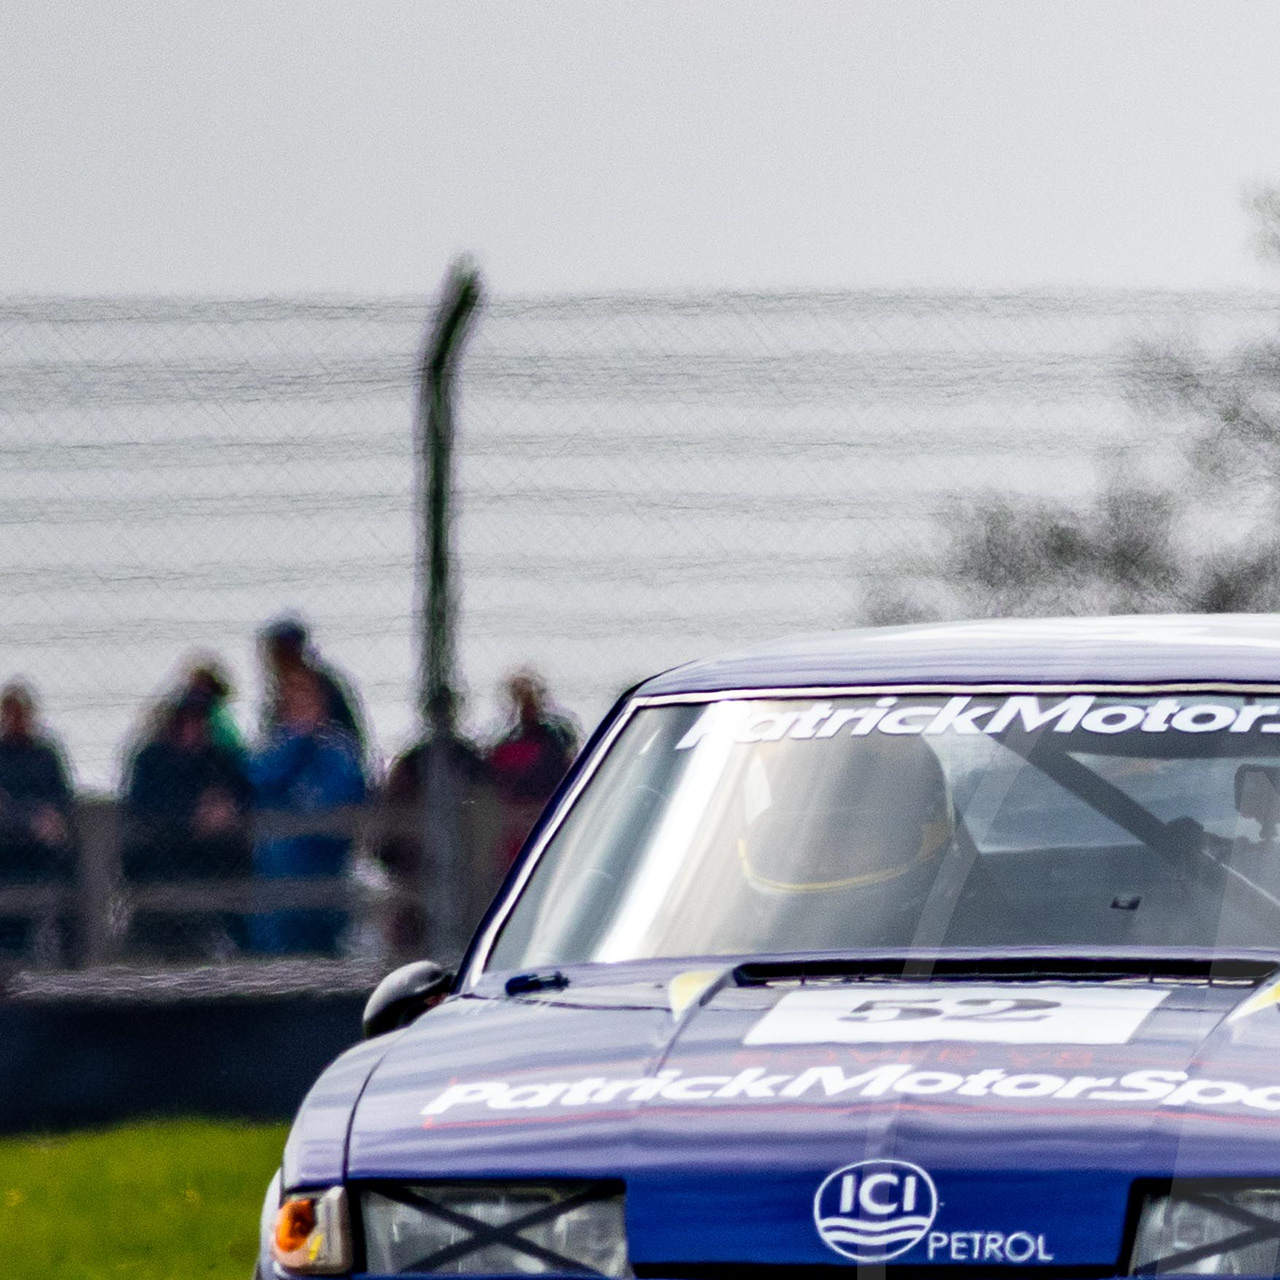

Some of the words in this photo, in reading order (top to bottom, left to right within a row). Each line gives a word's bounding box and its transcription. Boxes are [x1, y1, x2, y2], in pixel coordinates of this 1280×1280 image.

[837, 998, 1062, 1024] 52
[838, 1172, 917, 1216] ICI
[926, 1231, 1055, 1264] PETROL
